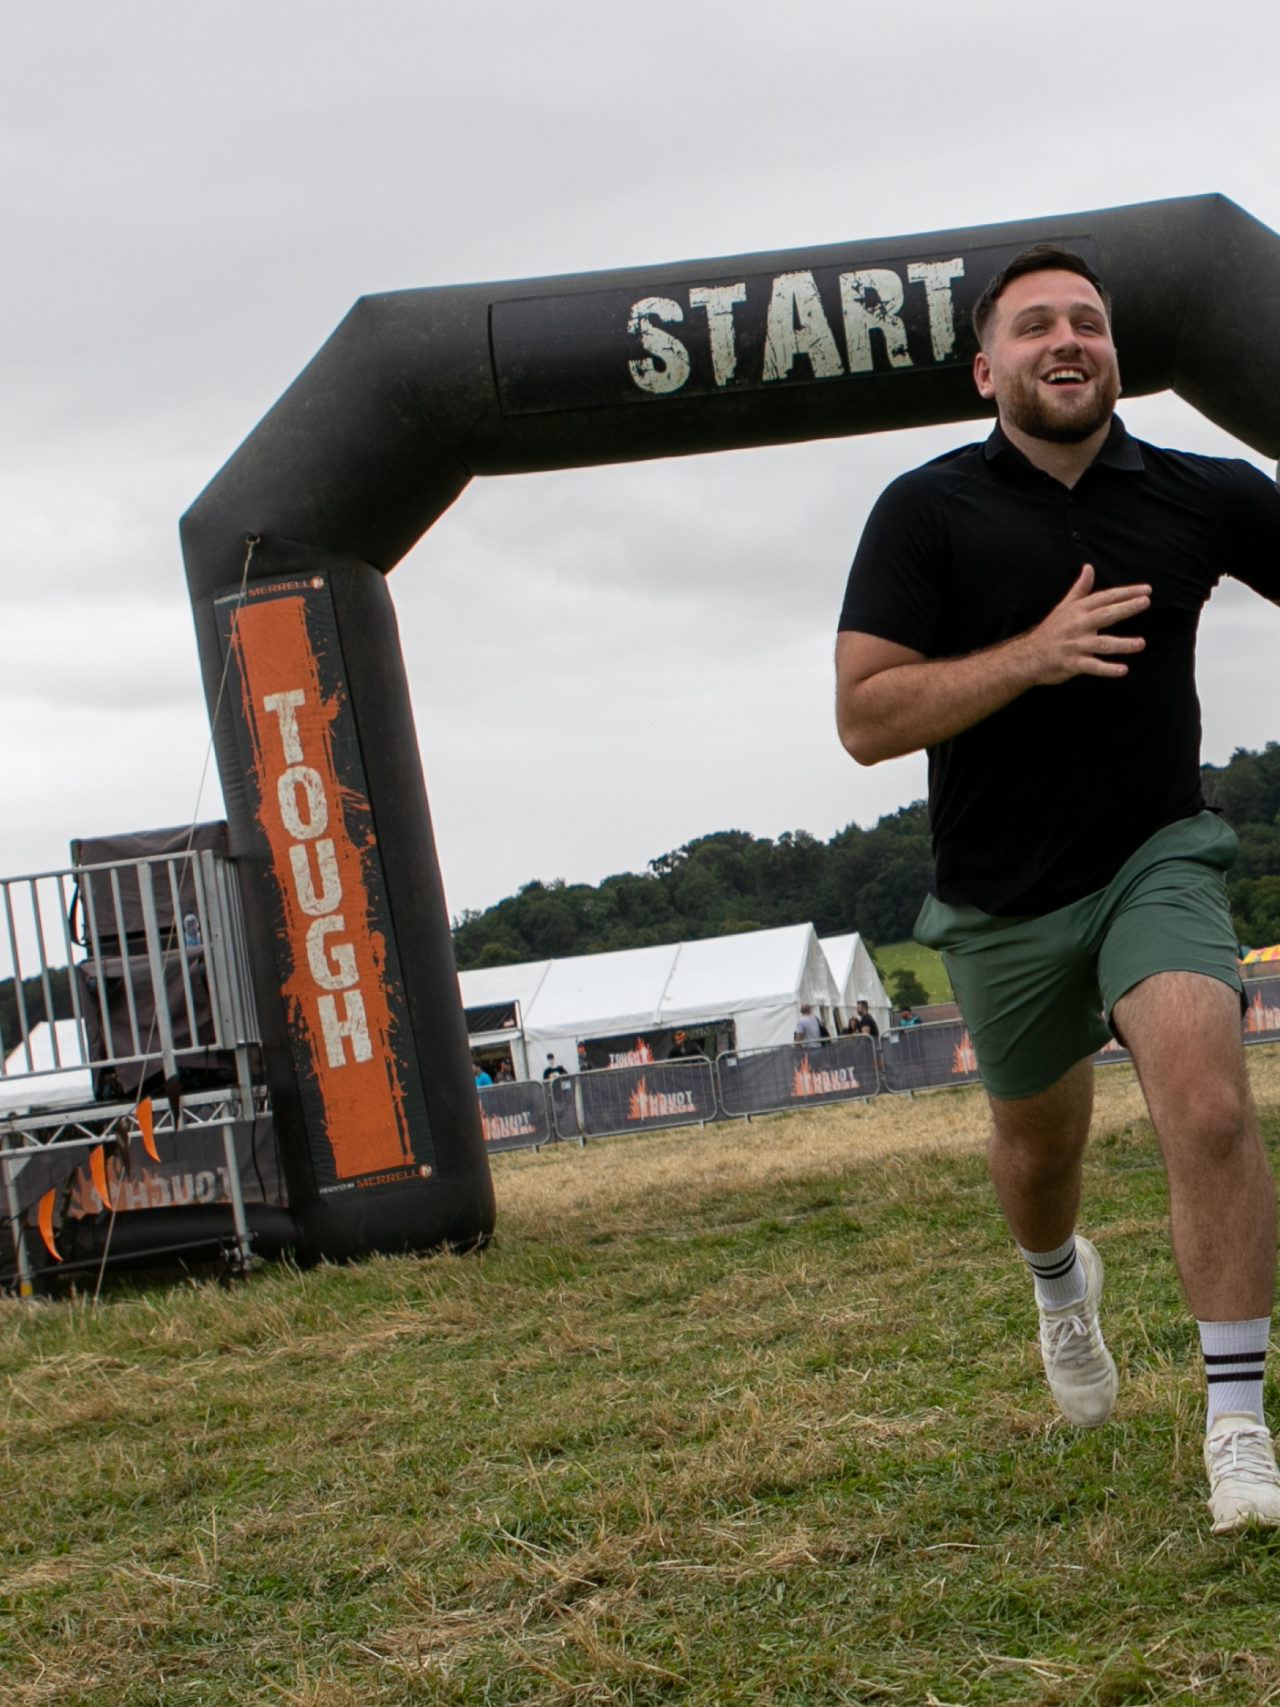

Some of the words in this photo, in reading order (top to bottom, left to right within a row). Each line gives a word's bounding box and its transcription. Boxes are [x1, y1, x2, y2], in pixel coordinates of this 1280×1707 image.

[627, 257, 965, 394] START
[248, 580, 310, 597] MERRELL
[263, 688, 374, 1069] TOUGH
[356, 1169, 420, 1188] MERRELL
